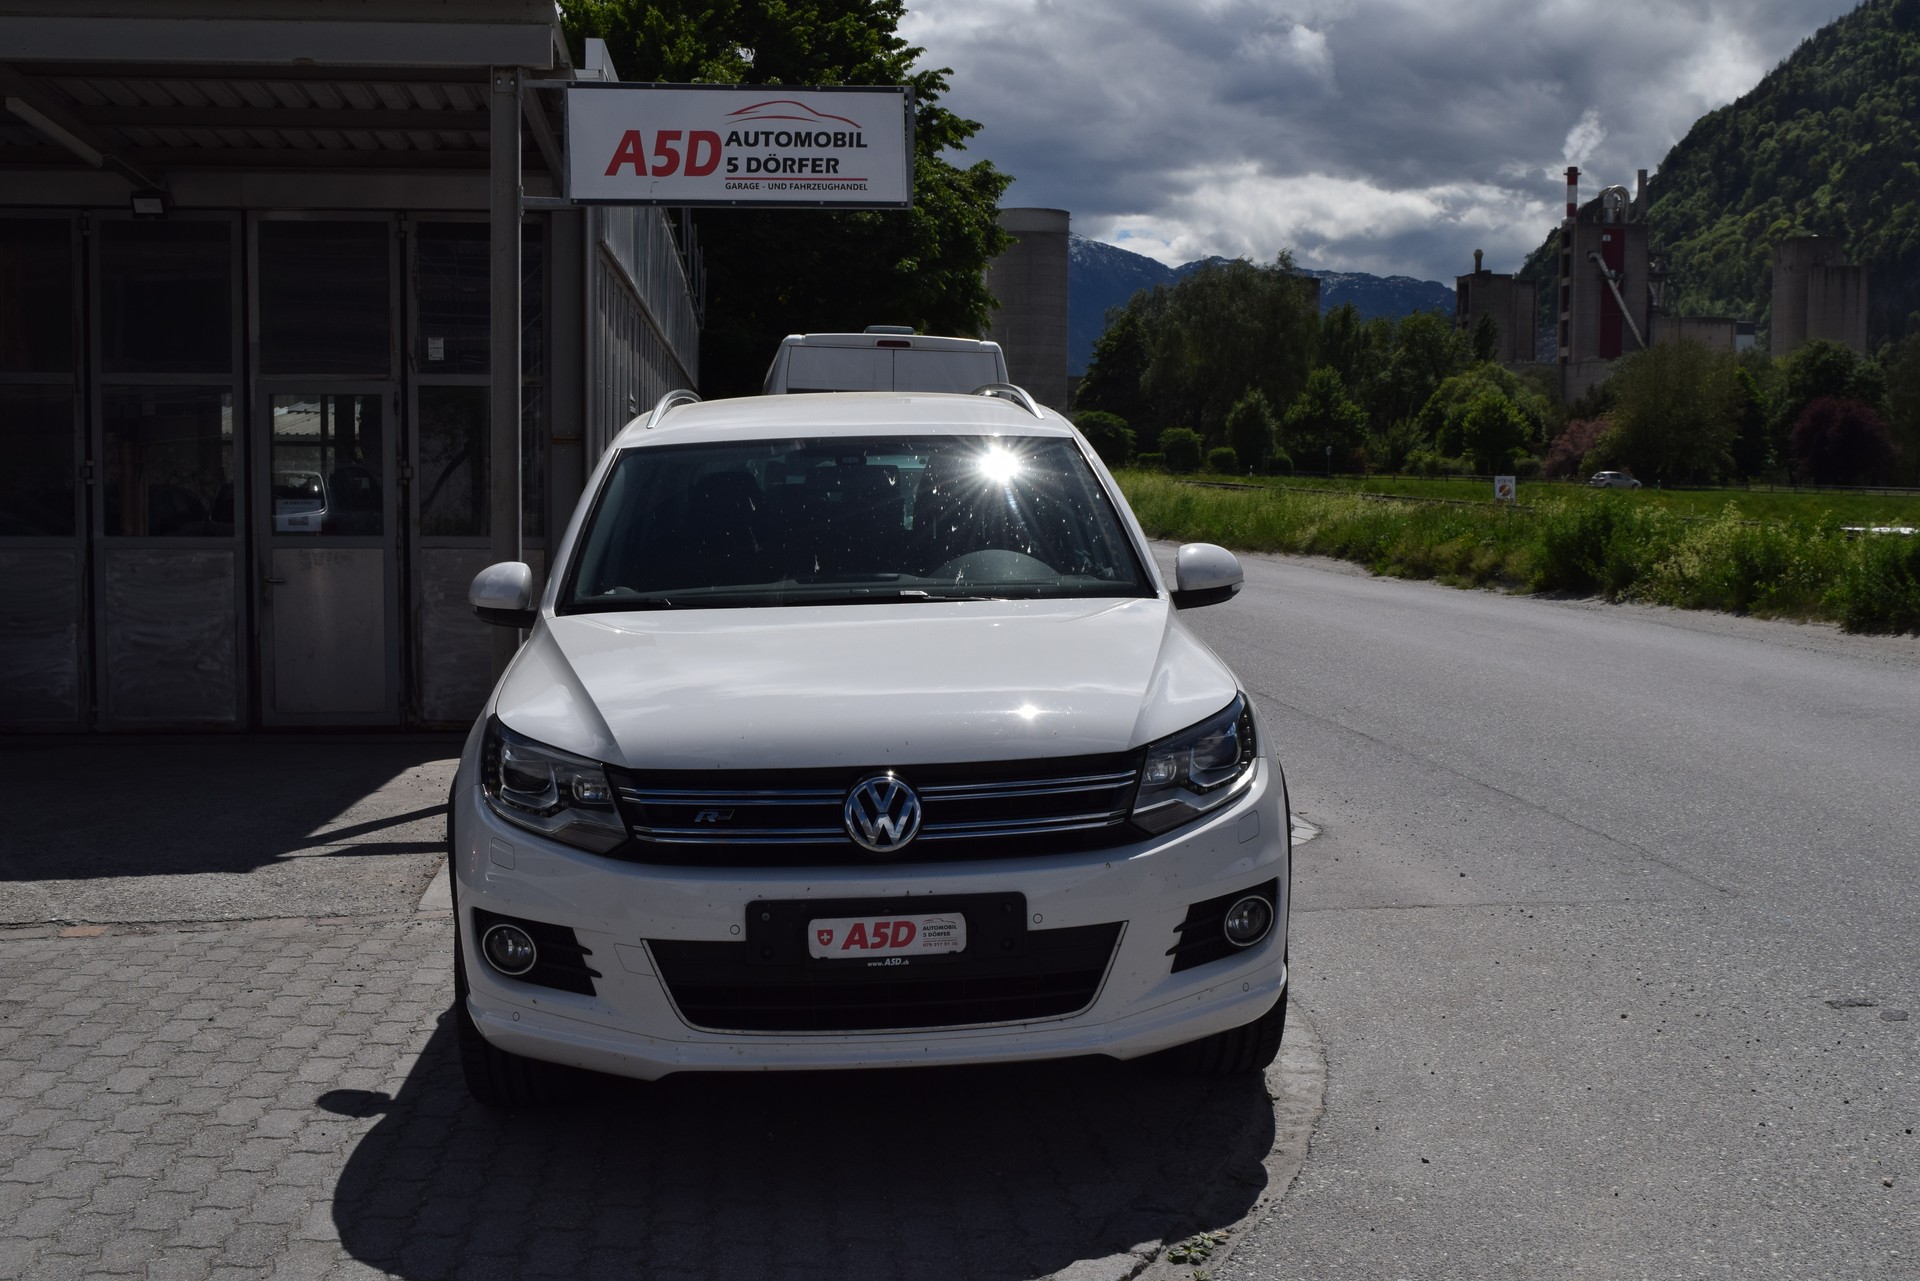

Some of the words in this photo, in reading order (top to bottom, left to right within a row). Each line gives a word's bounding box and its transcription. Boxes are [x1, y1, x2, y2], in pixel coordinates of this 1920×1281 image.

[724, 130, 868, 148] AUTOMOBIL
[604, 129, 723, 177] A5D
[726, 156, 739, 174] 5
[746, 153, 840, 174] DÖRFER
[725, 182, 761, 191] GARAGE
[767, 182, 787, 191] UND
[789, 182, 868, 191] FAHRZEUGHANDEL
[841, 920, 917, 950] A5D
